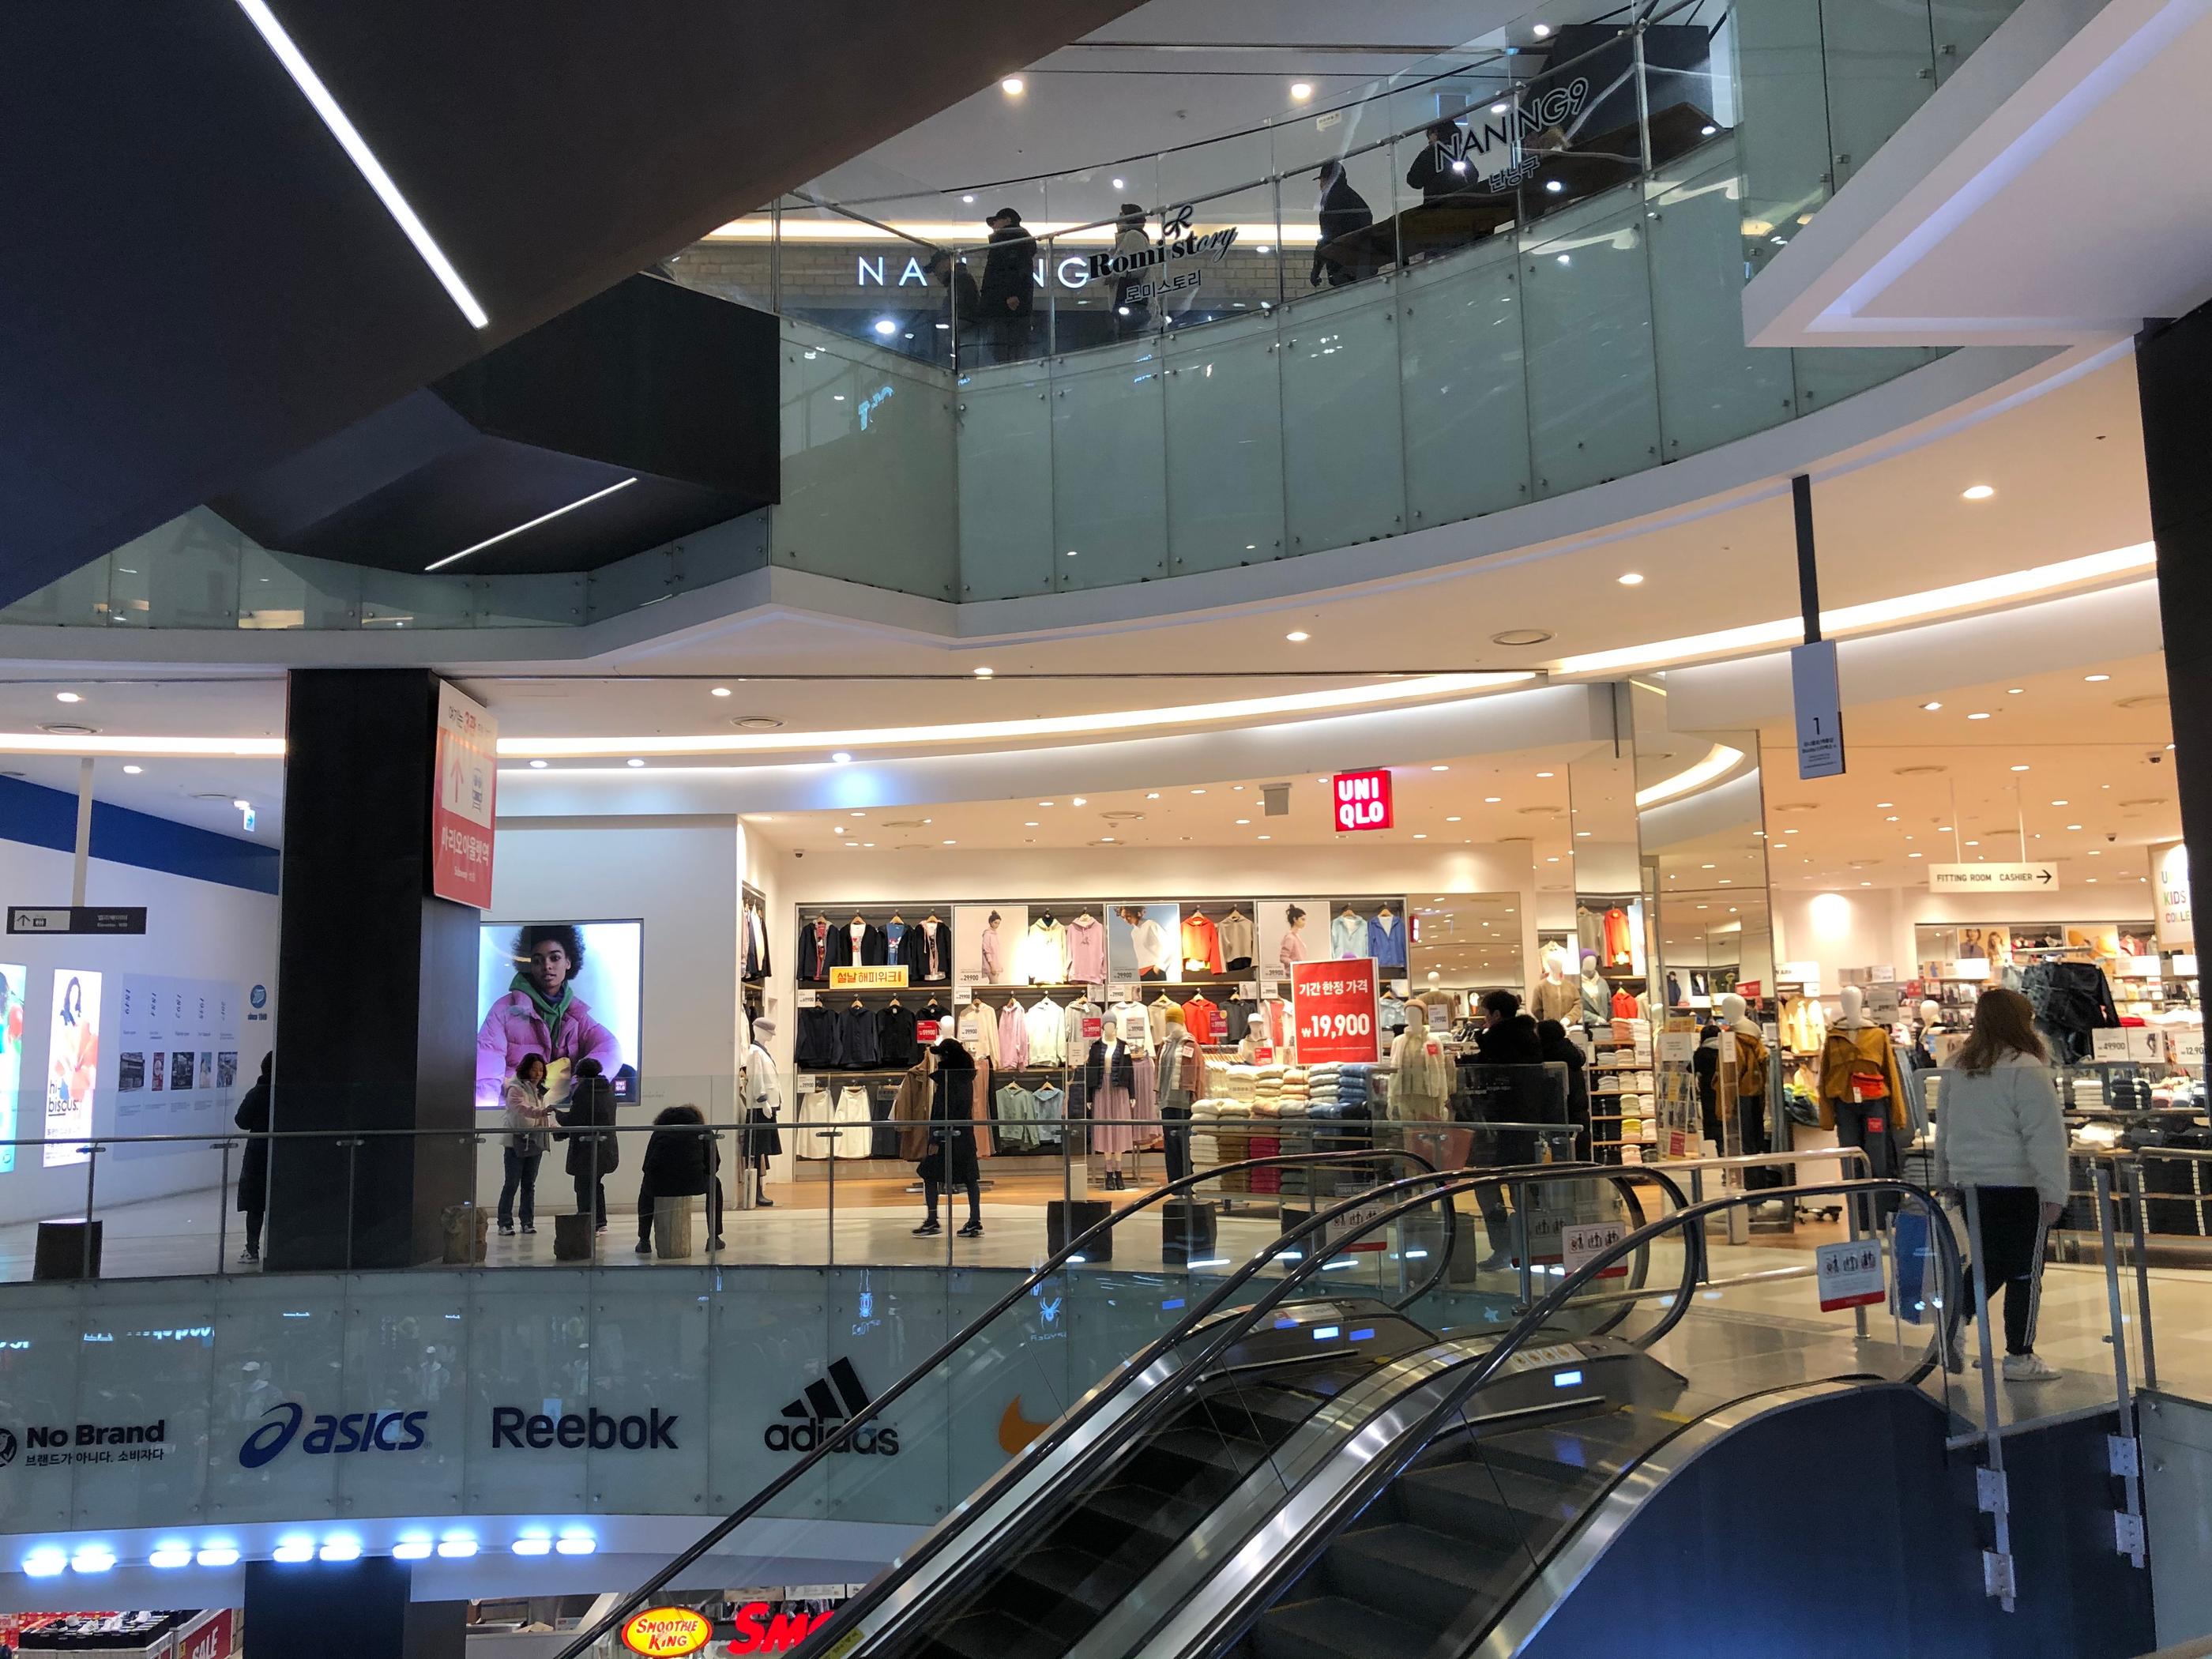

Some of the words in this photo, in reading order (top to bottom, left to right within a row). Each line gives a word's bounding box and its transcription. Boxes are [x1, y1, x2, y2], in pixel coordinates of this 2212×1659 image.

[1435, 77, 1589, 173] NANING9
[1489, 156, 1540, 193] 난닝구
[1089, 239, 1165, 280] Romi
[1172, 227, 1239, 265] story
[1124, 269, 1202, 304] 로미스토리
[1813, 717, 1820, 735] 1
[1338, 777, 1379, 801] UNI
[1339, 800, 1384, 828] QLO
[1936, 874, 1967, 882] FITTING
[1999, 873, 2033, 882] CASHIER
[2164, 890, 2187, 905] KIDS
[837, 971, 857, 984] 설날
[1299, 982, 1321, 997] 기간
[1322, 980, 1344, 995] 한정
[1346, 979, 1368, 994] 가격
[27, 1427, 68, 1448] No
[76, 1420, 165, 1446] Brand
[492, 1407, 679, 1450] Reebok
[25, 1453, 73, 1466] 브랜드가
[118, 1448, 164, 1462] 소비자다
[636, 1619, 698, 1634] SMOOTHIE
[648, 1635, 687, 1651] KING
